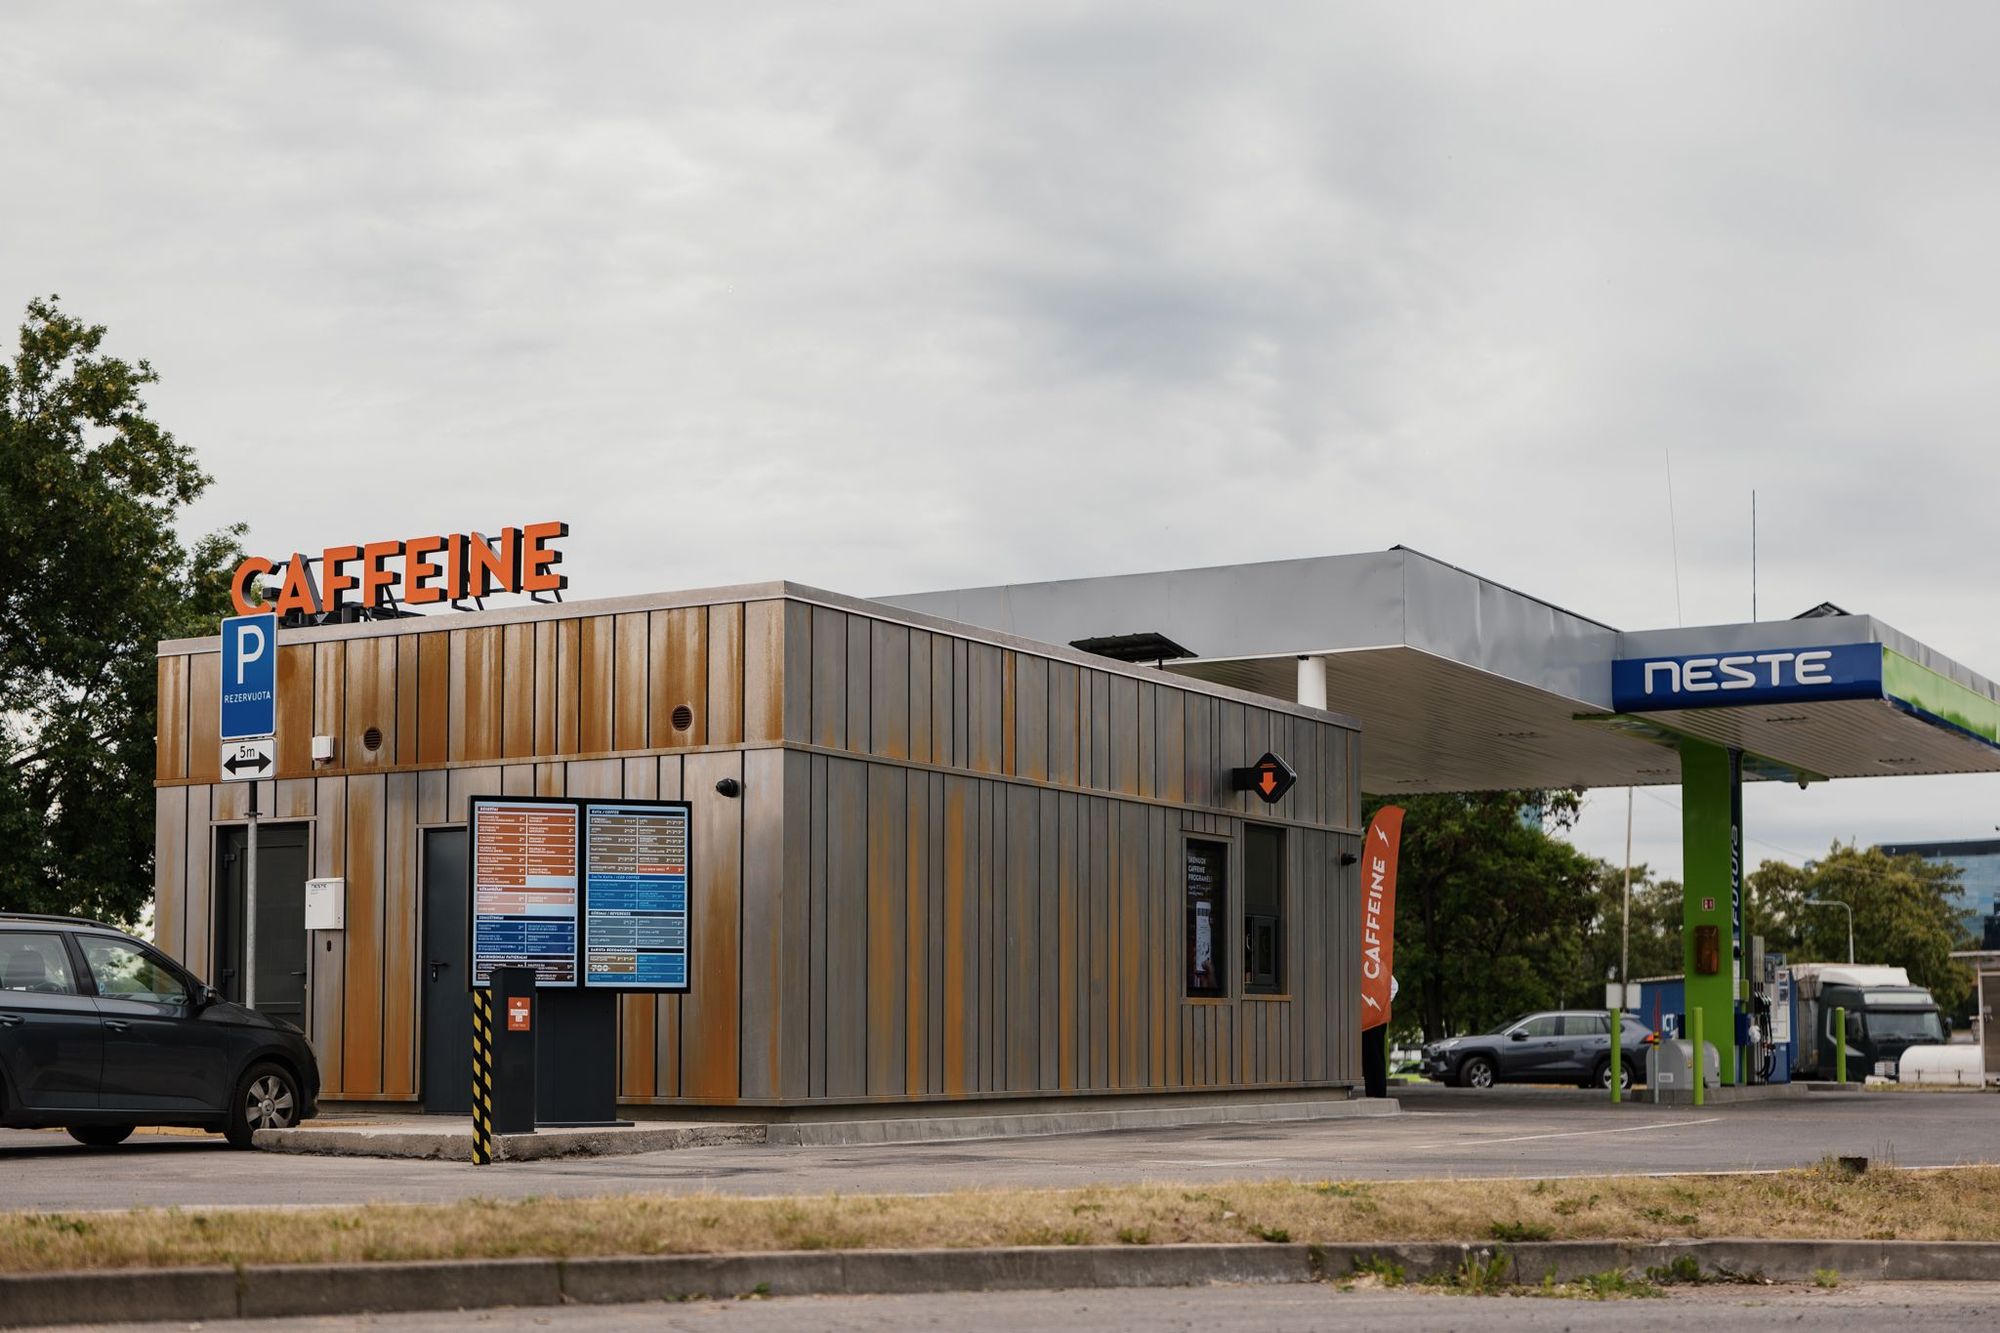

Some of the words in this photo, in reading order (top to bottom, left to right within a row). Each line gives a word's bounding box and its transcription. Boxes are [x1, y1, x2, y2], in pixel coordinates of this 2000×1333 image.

[231, 521, 566, 617] CAFFEINE
[237, 625, 265, 684] P
[1645, 651, 1832, 694] NESTE
[224, 691, 271, 703] REZERVUOTA
[240, 746, 255, 758] 5m
[1364, 856, 1385, 979] CAFFEINE
